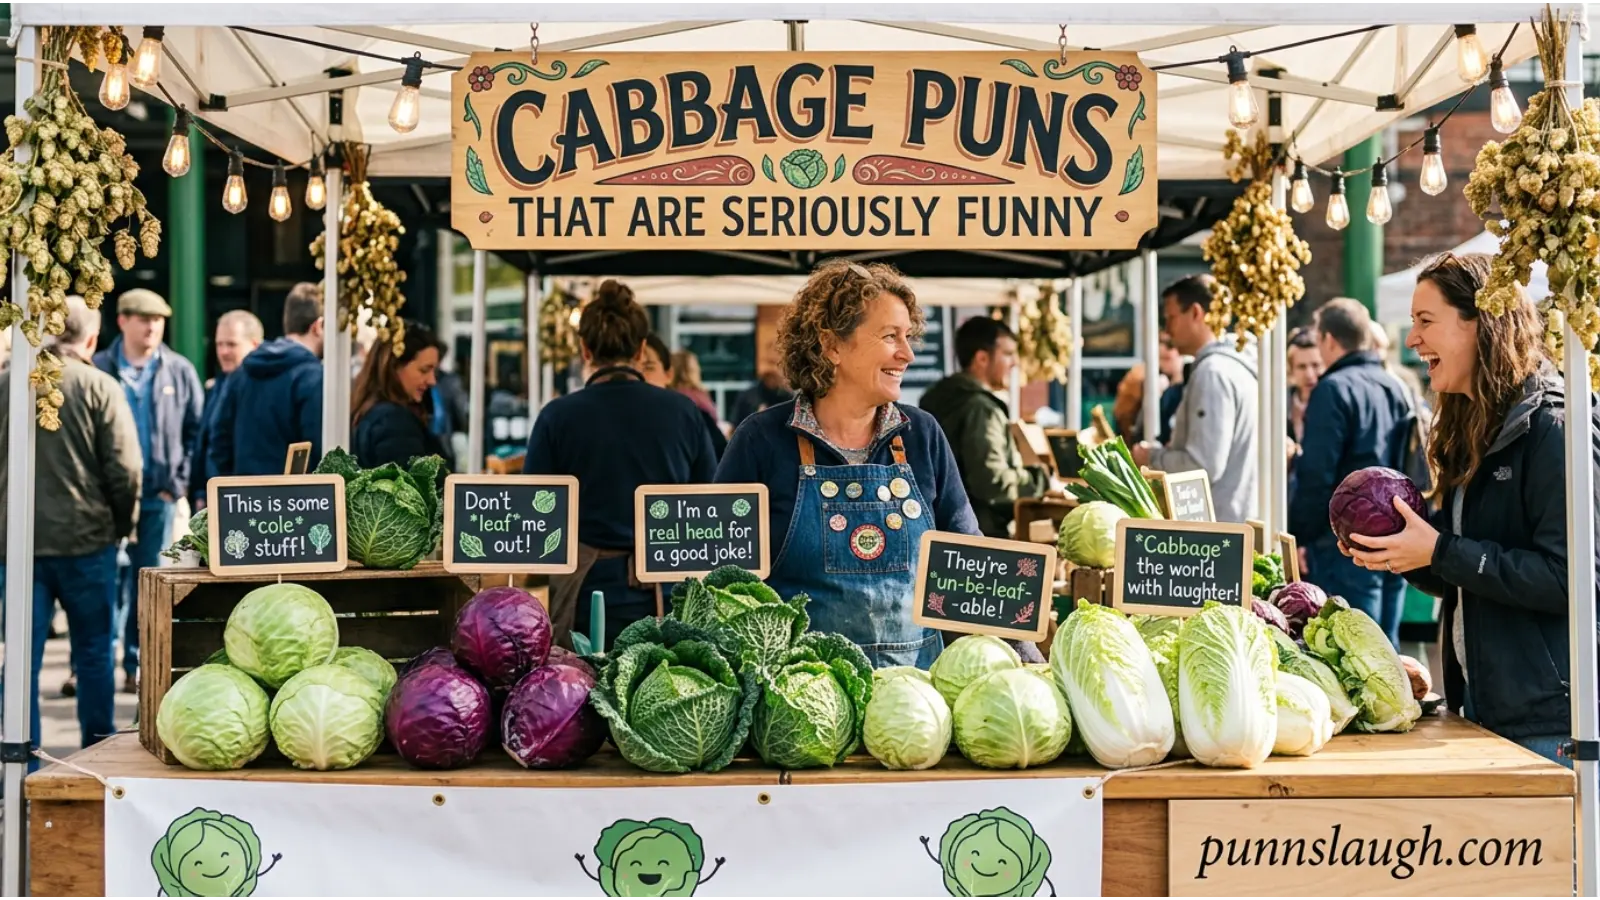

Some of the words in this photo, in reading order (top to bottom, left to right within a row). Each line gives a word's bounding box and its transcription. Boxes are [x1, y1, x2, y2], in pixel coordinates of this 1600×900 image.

[492, 63, 874, 187] CABBAGE
[901, 68, 1118, 188] PUNS
[508, 197, 614, 236] THAT
[627, 197, 705, 236] ARE
[721, 196, 940, 237] SERIOUSLY
[957, 196, 1103, 237] FUNNY
[223, 494, 262, 513] This
[268, 496, 282, 512] is
[287, 498, 330, 511] some
[465, 491, 512, 510] Don't
[677, 500, 701, 518] I'm
[707, 505, 718, 518] a
[522, 519, 547, 532] me
[649, 522, 680, 541] real
[686, 521, 723, 540] head
[728, 521, 752, 539] for
[255, 535, 305, 557] stuff!
[494, 534, 530, 553] out!
[654, 549, 665, 562] a
[670, 543, 709, 567] good
[711, 541, 752, 566] joke!
[943, 549, 1008, 579] They're
[1136, 557, 1164, 575] the
[1169, 559, 1215, 579] world
[1127, 578, 1163, 597] with
[1169, 579, 1239, 605] laughter!
[952, 597, 1004, 619] -able!
[1194, 824, 1544, 880] punnslaugh.com
